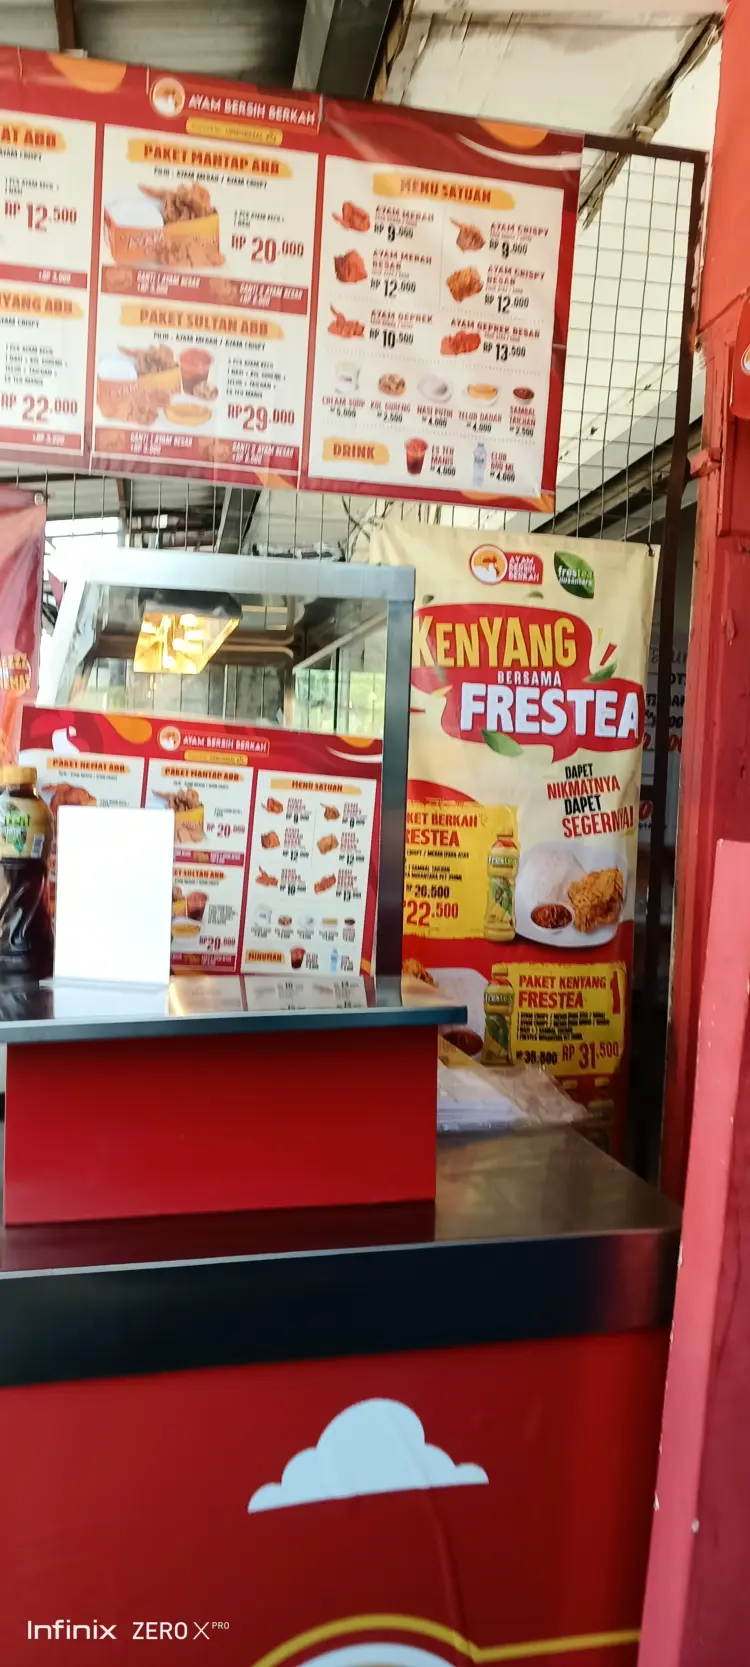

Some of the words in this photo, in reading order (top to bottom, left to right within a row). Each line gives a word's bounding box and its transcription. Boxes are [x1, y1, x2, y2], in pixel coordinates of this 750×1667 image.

[188, 93, 221, 112] AYAM
[224, 98, 265, 119] BERSIH
[268, 105, 316, 126] BERKAH
[143, 143, 187, 163] PAKET
[191, 150, 249, 171] MANTAP
[400, 178, 439, 197] MENU
[441, 181, 492, 205] SATUAN
[4, 200, 20, 217] RP
[26, 202, 77, 232] 12.500
[375, 204, 400, 217] AYAM
[402, 208, 434, 222] MERAH
[374, 223, 384, 235] RP
[387, 222, 414, 243] 9.000
[490, 221, 515, 233] AYAM
[517, 224, 549, 238] CRISPY
[231, 233, 246, 250] RP
[251, 236, 304, 265] 20.000
[372, 248, 398, 260] AYAM
[400, 251, 432, 266] MERAH
[489, 238, 499, 251] RP
[501, 240, 528, 260] 9.000
[486, 264, 512, 276] AYAM
[514, 267, 546, 281] CRISPY
[370, 278, 381, 291] RP
[383, 279, 416, 300] 12.000
[0, 291, 41, 311] YANG
[484, 293, 495, 306] RP
[497, 294, 530, 315] 12.000
[139, 307, 183, 327] PAKET
[187, 313, 237, 333] SULTAN
[371, 308, 396, 321] AYAM
[398, 312, 434, 325] GEPREK
[369, 328, 380, 341] RP
[450, 317, 475, 330] AYAM
[477, 322, 510, 335] GEPREK
[512, 326, 541, 339] BESAR
[483, 340, 493, 354] RP
[495, 342, 526, 363] 13.500
[1, 393, 16, 410] RP
[22, 393, 78, 423] 22.000
[333, 442, 376, 461] DRINK
[431, 455, 454, 467] MANIS
[508, 562, 536, 574] BERSIH
[509, 555, 534, 565] AYAM
[508, 570, 540, 583] BERKAH
[412, 614, 577, 669] KENYANG
[497, 671, 562, 688] BERSAMA
[460, 681, 640, 740] FRESTEA
[183, 733, 205, 747] AYAM
[206, 736, 234, 750] BERSIH
[235, 740, 267, 753] BERKAH
[53, 758, 78, 770] PAKET
[80, 761, 107, 773] HEMAT
[164, 768, 190, 779] PAKET
[191, 770, 222, 781] MANTAP
[564, 762, 594, 780] DAPET
[292, 780, 314, 790] MENU
[315, 782, 343, 794] SATUAN
[546, 775, 621, 800] NIKMATNYA
[564, 794, 602, 816] DAPET
[431, 811, 478, 828] BERKAH
[206, 823, 215, 832] RP
[217, 823, 246, 839] 20.000
[184, 869, 209, 879] SULTAN
[406, 899, 459, 927] 22.500
[518, 974, 556, 989] PAKET
[558, 976, 607, 990] KENYANG
[518, 989, 584, 1009] FRESTEA
[562, 1042, 575, 1061] RP
[578, 1040, 620, 1070] 31.500
